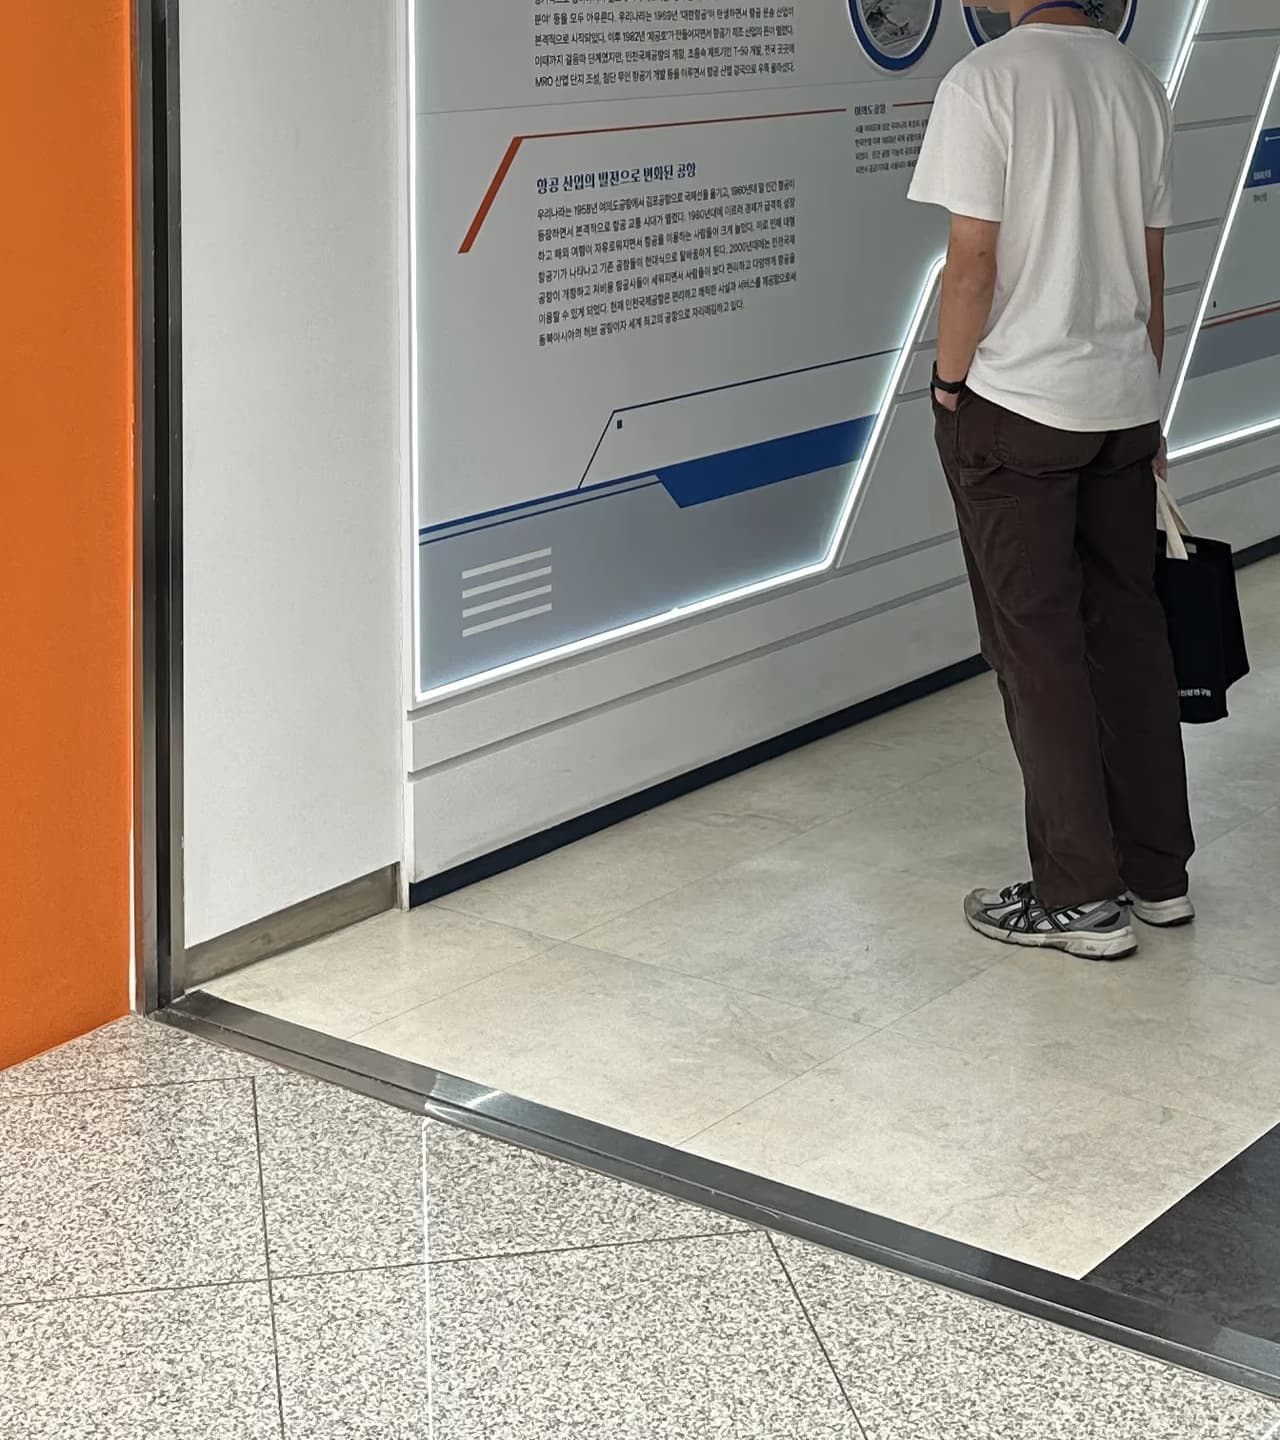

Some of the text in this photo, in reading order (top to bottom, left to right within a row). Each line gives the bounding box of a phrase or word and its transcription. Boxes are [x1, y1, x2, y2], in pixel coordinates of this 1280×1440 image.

[536, 162, 696, 194] 항공 산업의 발전으로 변화된 공항
